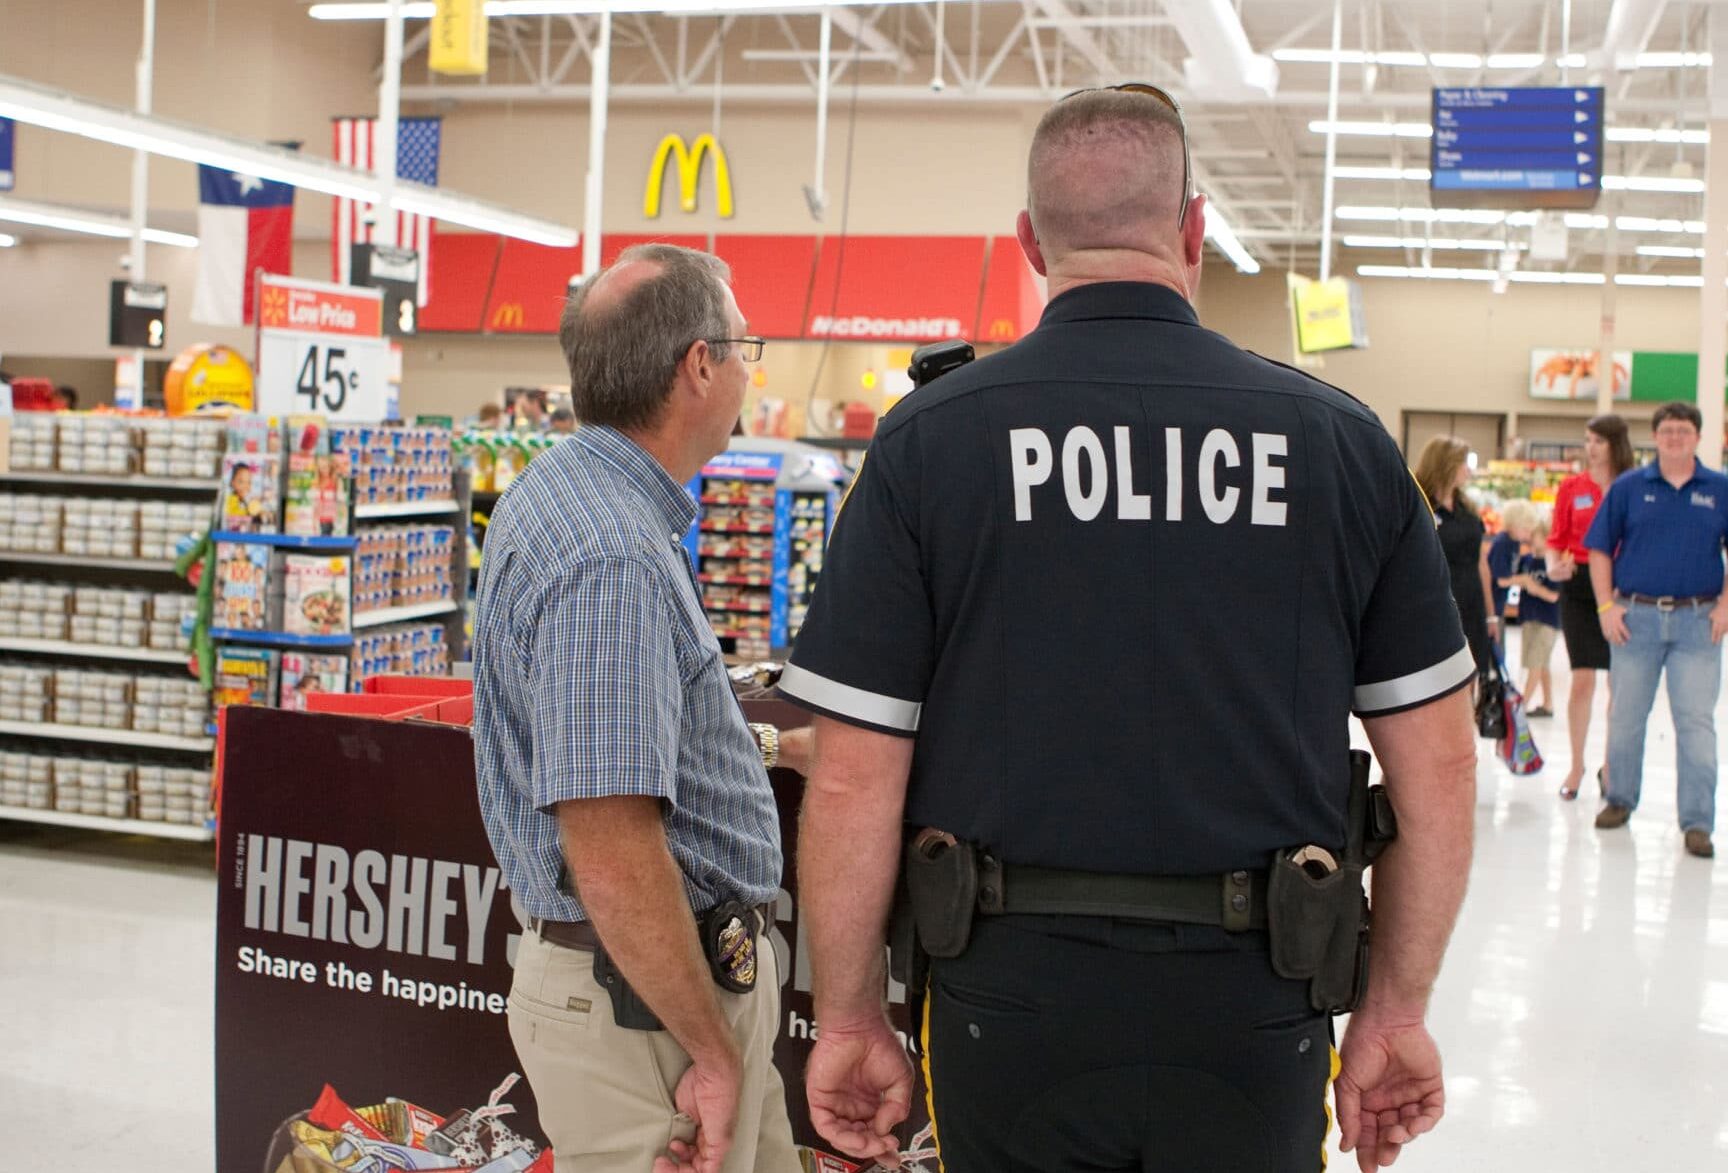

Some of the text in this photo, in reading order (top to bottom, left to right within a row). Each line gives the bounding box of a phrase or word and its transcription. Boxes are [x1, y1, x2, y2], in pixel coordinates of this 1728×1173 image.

[288, 300, 357, 328] Low Price
[811, 316, 960, 337] McDonald's
[1009, 425, 1289, 526] POLICE
[234, 858, 245, 888] SINCE
[237, 946, 317, 983] Share
[326, 962, 373, 993] the
